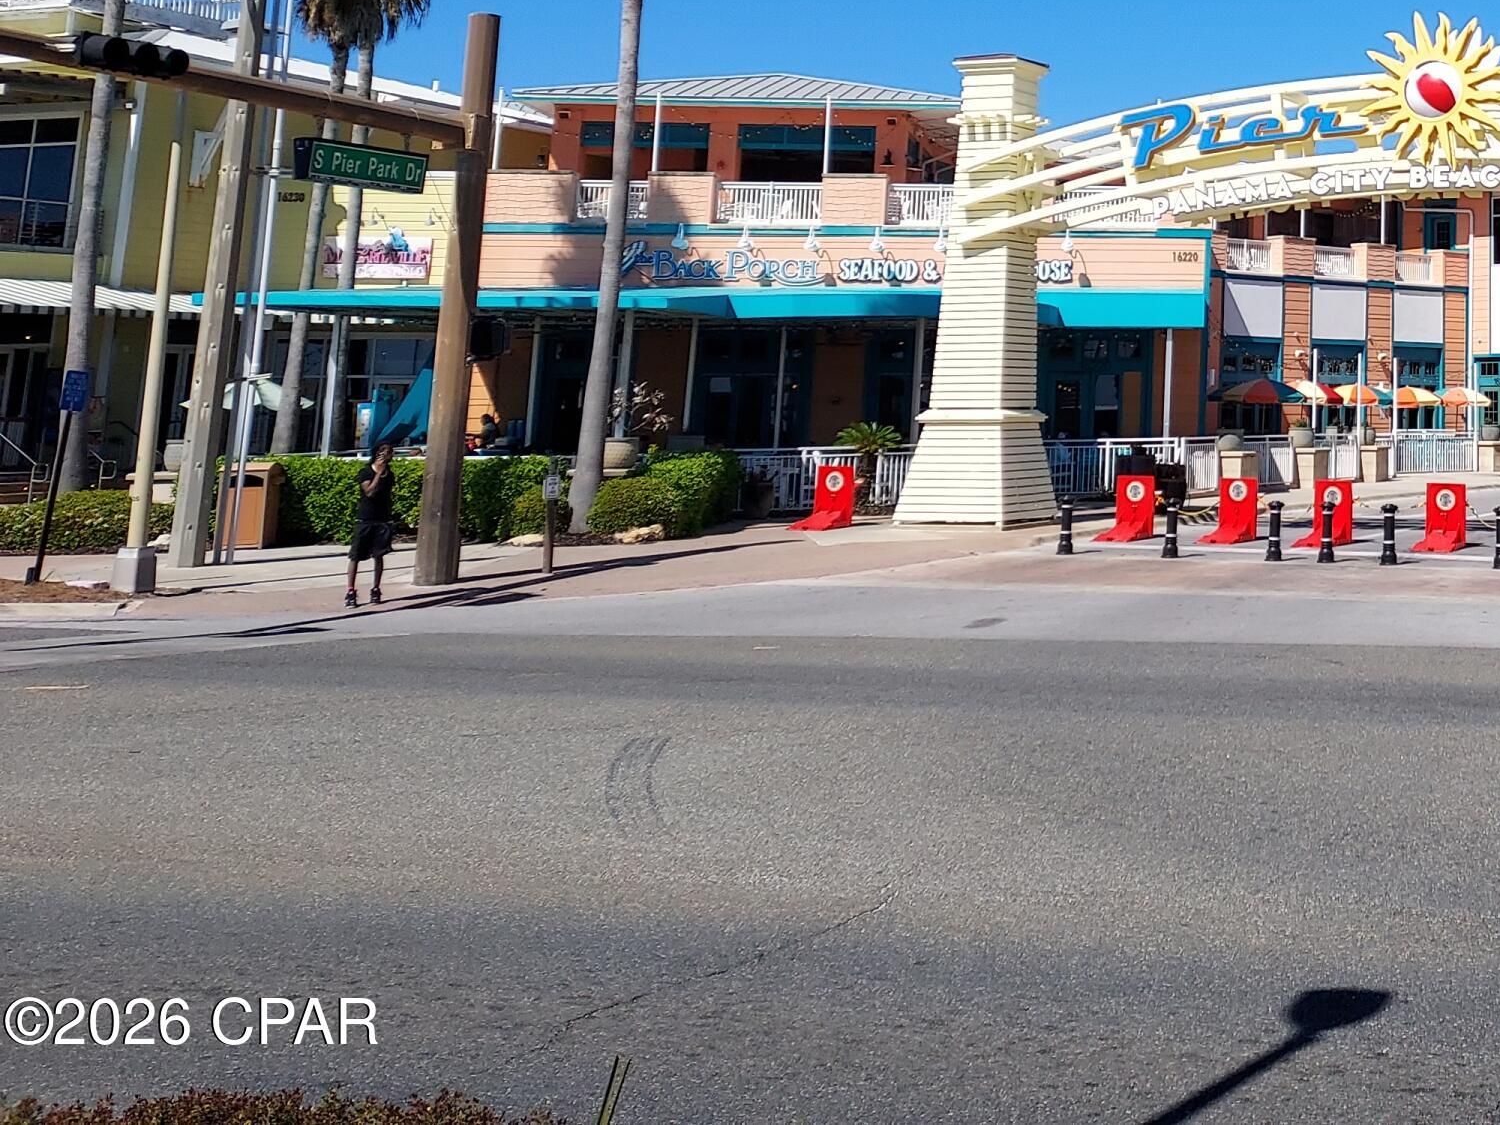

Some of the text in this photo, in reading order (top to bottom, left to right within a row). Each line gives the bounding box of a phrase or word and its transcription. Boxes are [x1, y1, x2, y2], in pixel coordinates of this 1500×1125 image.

[1120, 93, 1369, 170] Pier
[314, 150, 422, 183] S Pier Park Dr
[277, 191, 305, 203] 16230
[1152, 173, 1294, 218] PANAMA
[1309, 166, 1393, 196] CITY
[652, 250, 722, 281] BACK
[723, 250, 826, 286] PORCH
[838, 258, 919, 283] SEAFOOD
[922, 258, 941, 282] &
[1034, 259, 1073, 283] USE
[1172, 251, 1199, 263] 16220
